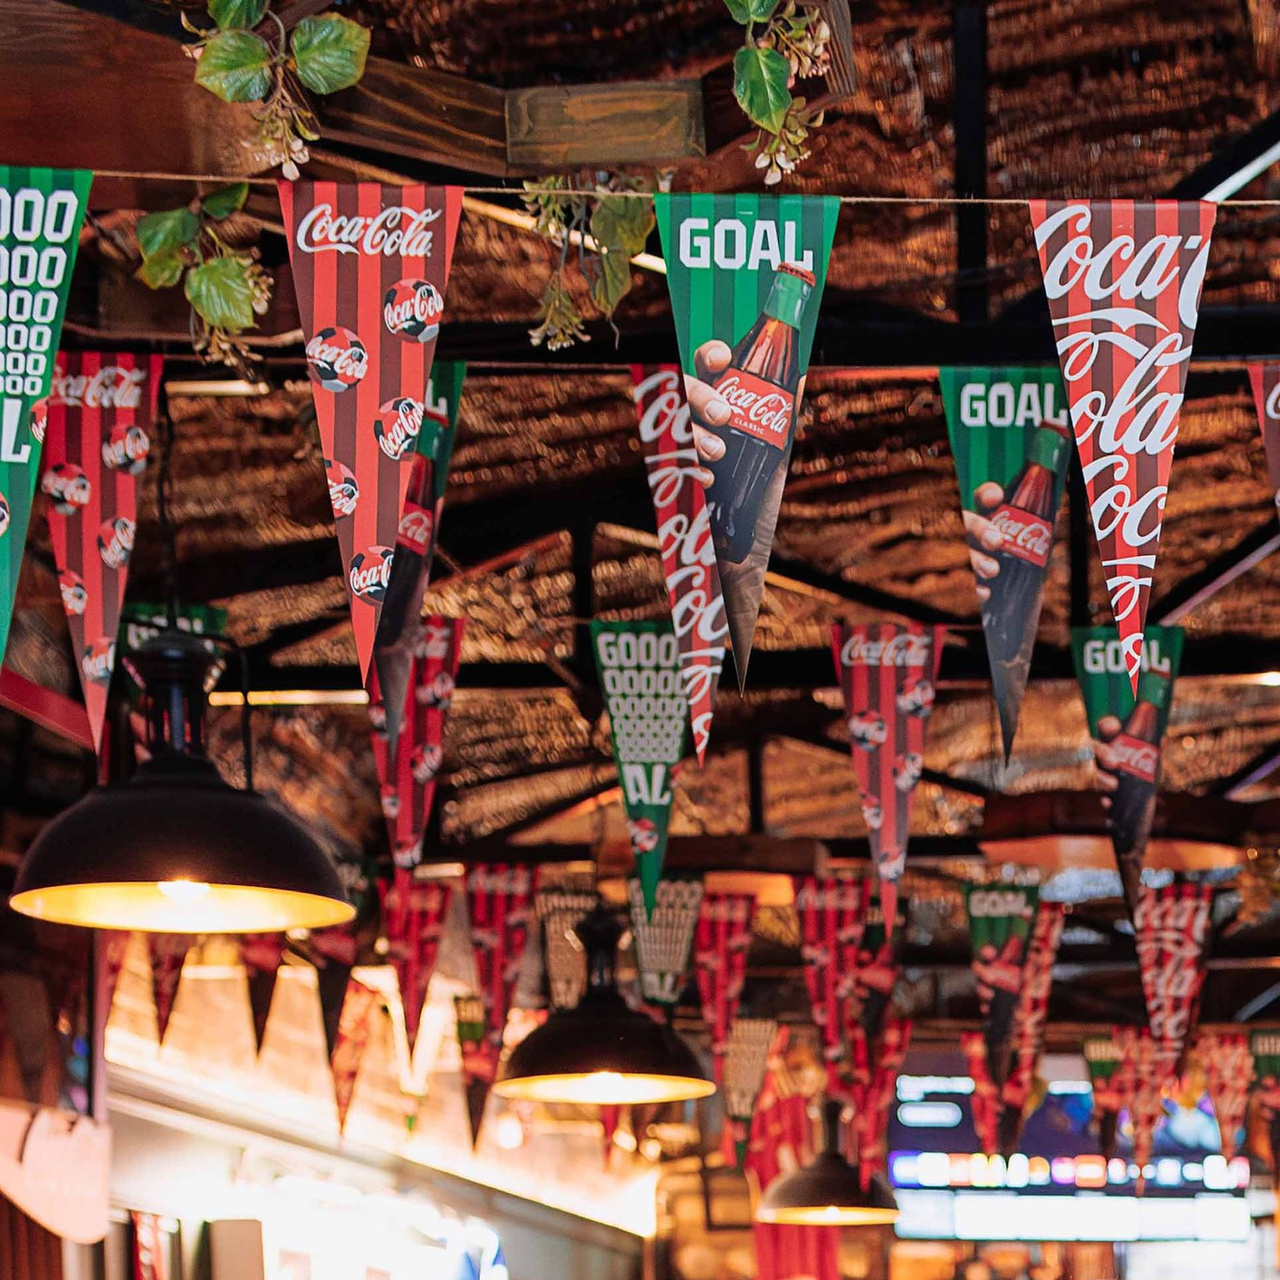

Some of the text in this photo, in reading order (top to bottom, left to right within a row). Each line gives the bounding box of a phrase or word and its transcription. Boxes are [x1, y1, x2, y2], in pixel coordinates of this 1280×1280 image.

[297, 203, 442, 257] Coca-Cola
[679, 218, 813, 272] GOAL
[960, 383, 1067, 428] GOAL
[597, 632, 682, 669] GOOO
[623, 763, 672, 805] AL
